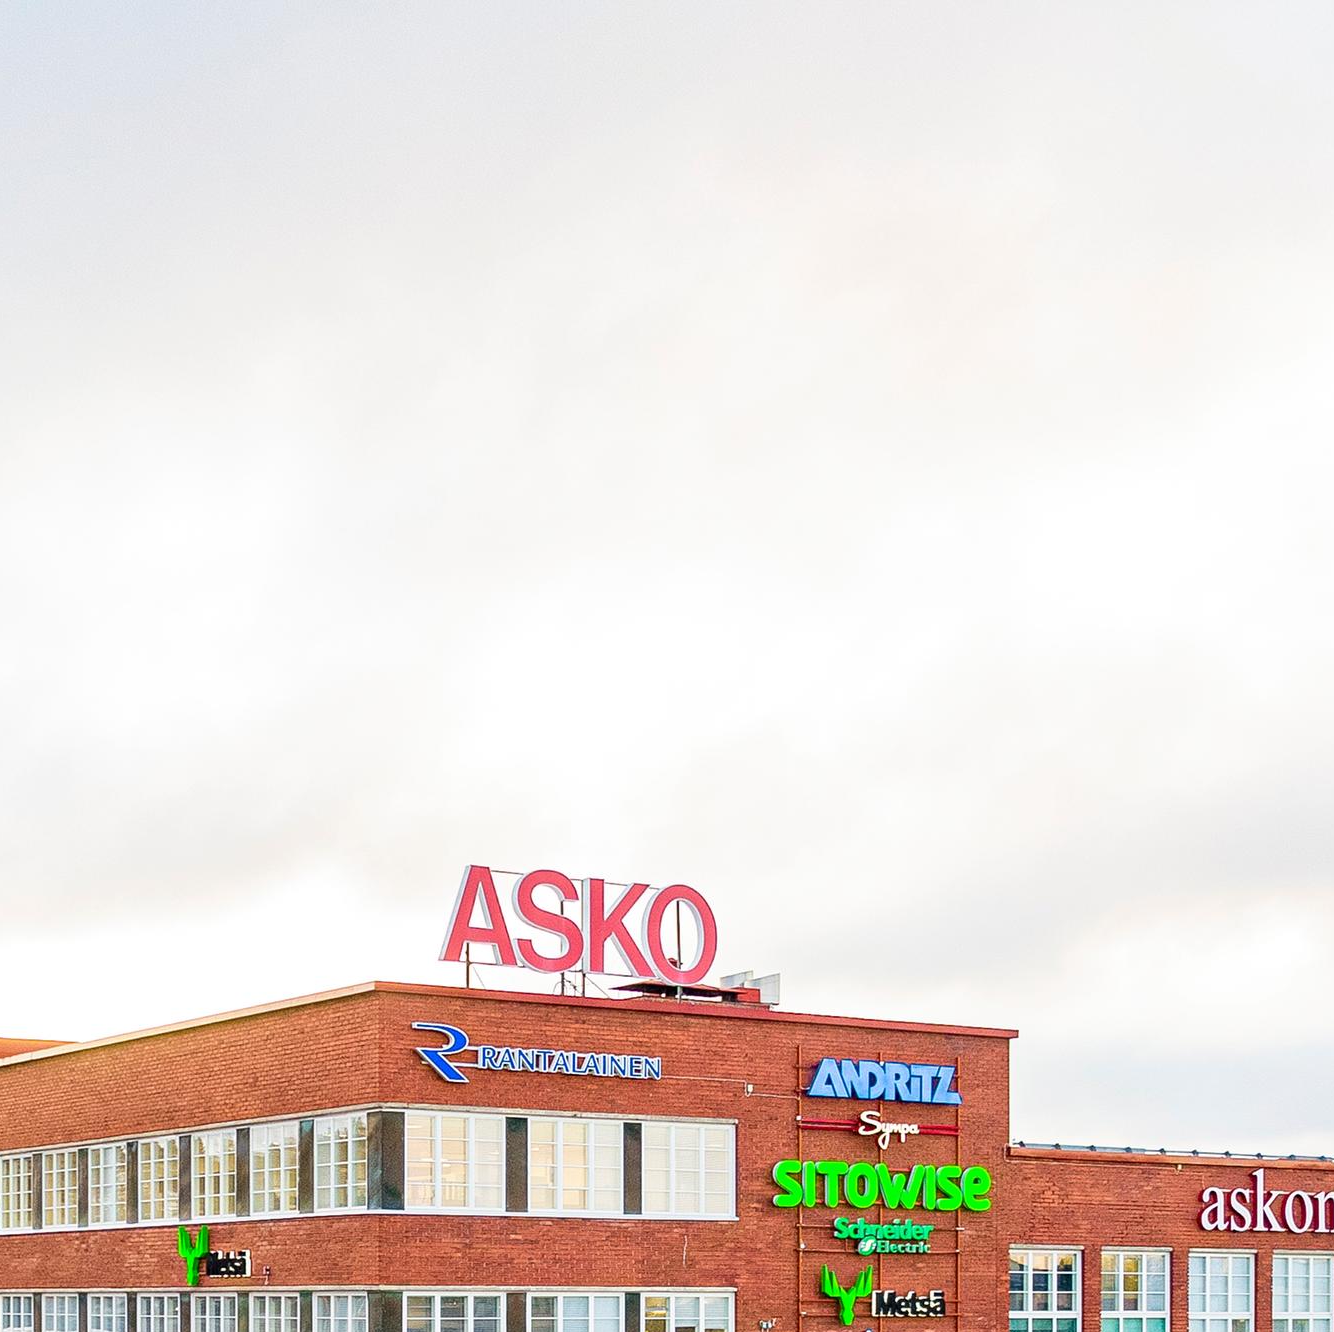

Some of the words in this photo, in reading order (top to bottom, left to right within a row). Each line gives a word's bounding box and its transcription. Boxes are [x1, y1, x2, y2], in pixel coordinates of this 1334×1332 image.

[439, 865, 717, 986] ASKO
[478, 1045, 663, 1081] RANTALAINEN
[858, 1111, 920, 1150] Sympa
[834, 1217, 934, 1241] Schneider
[875, 1240, 931, 1254] Electric
